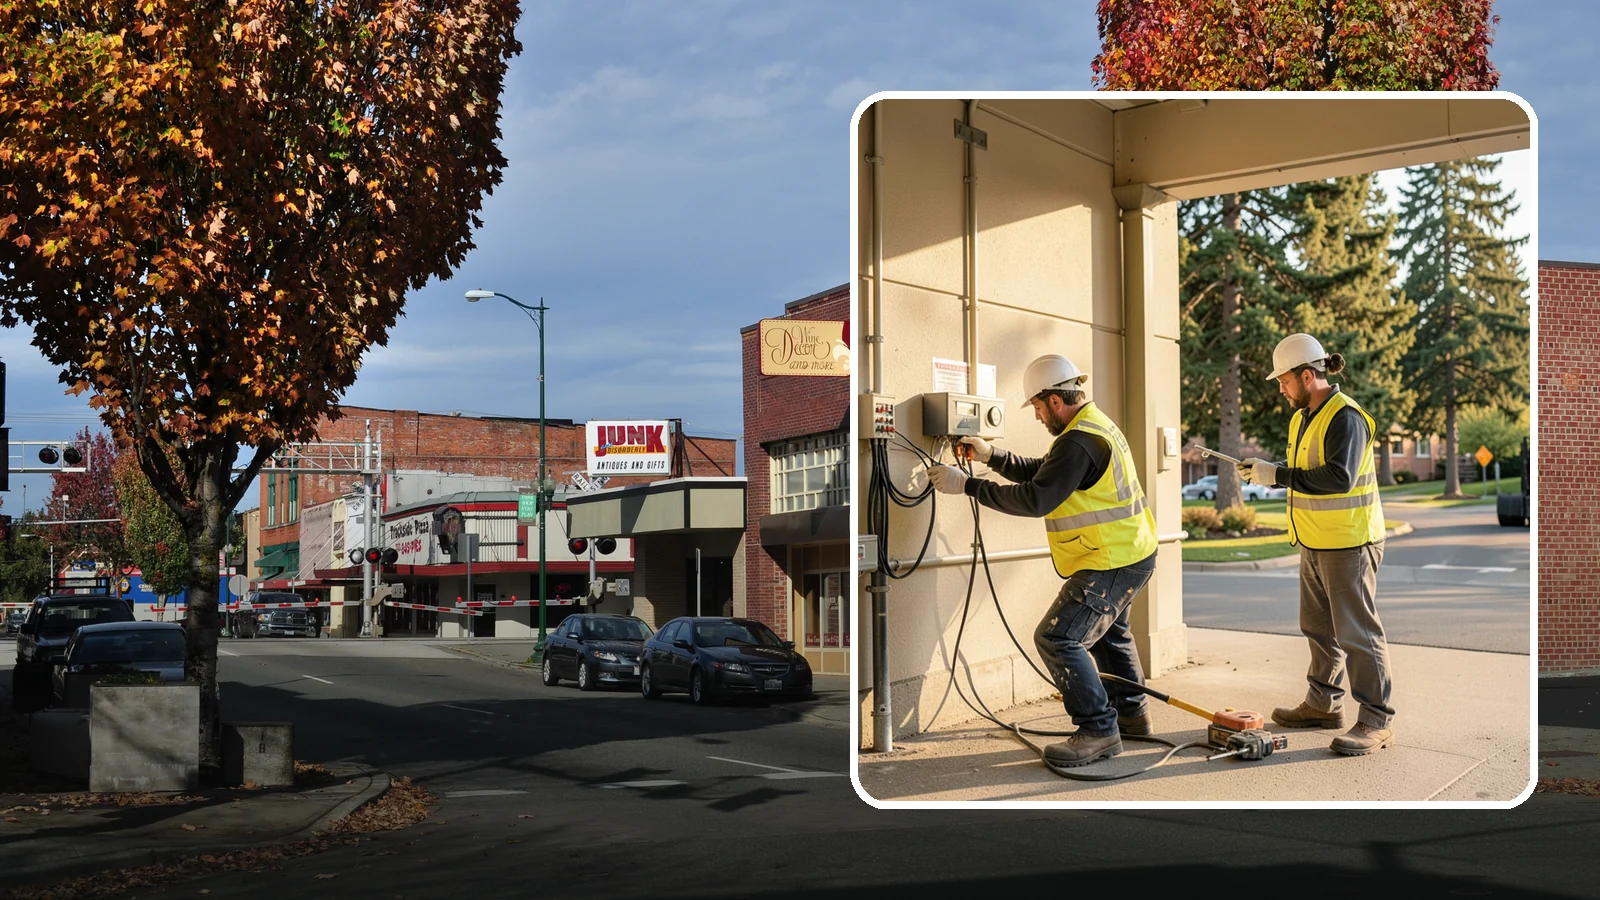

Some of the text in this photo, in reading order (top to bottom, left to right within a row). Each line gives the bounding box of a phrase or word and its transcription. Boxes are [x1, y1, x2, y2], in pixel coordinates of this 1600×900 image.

[596, 425, 665, 457] JUNK
[607, 446, 646, 454] DISORDERLY
[597, 460, 666, 470] ANTIQUES AND GIFTS
[390, 519, 429, 539] Trackside Pizza
